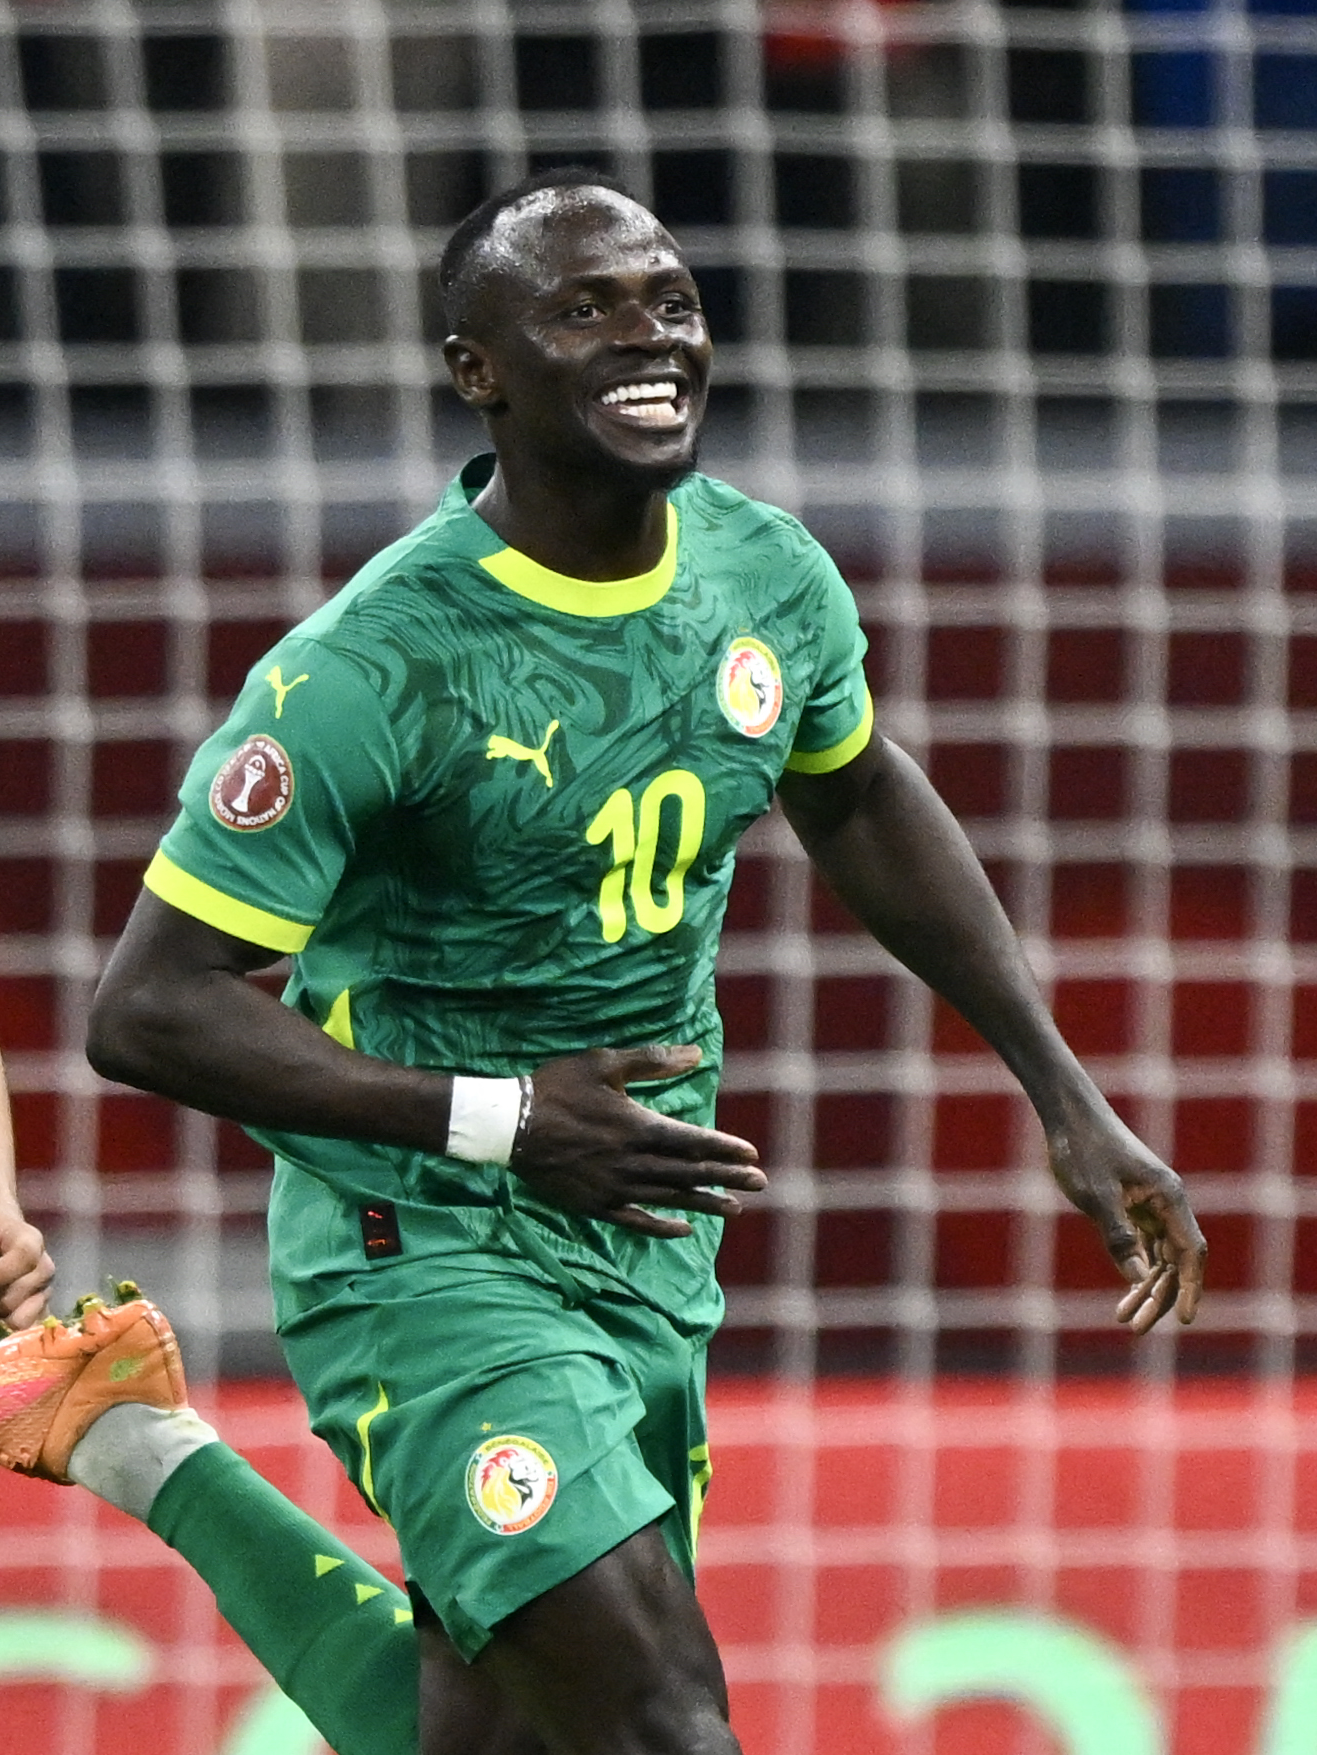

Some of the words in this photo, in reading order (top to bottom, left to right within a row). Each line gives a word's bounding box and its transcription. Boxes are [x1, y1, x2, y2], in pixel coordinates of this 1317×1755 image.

[264, 744, 287, 774] AFRICA
[280, 775, 290, 796] CUP
[274, 796, 286, 811] OF
[236, 807, 277, 826] NATIONS
[586, 769, 705, 943] 10
